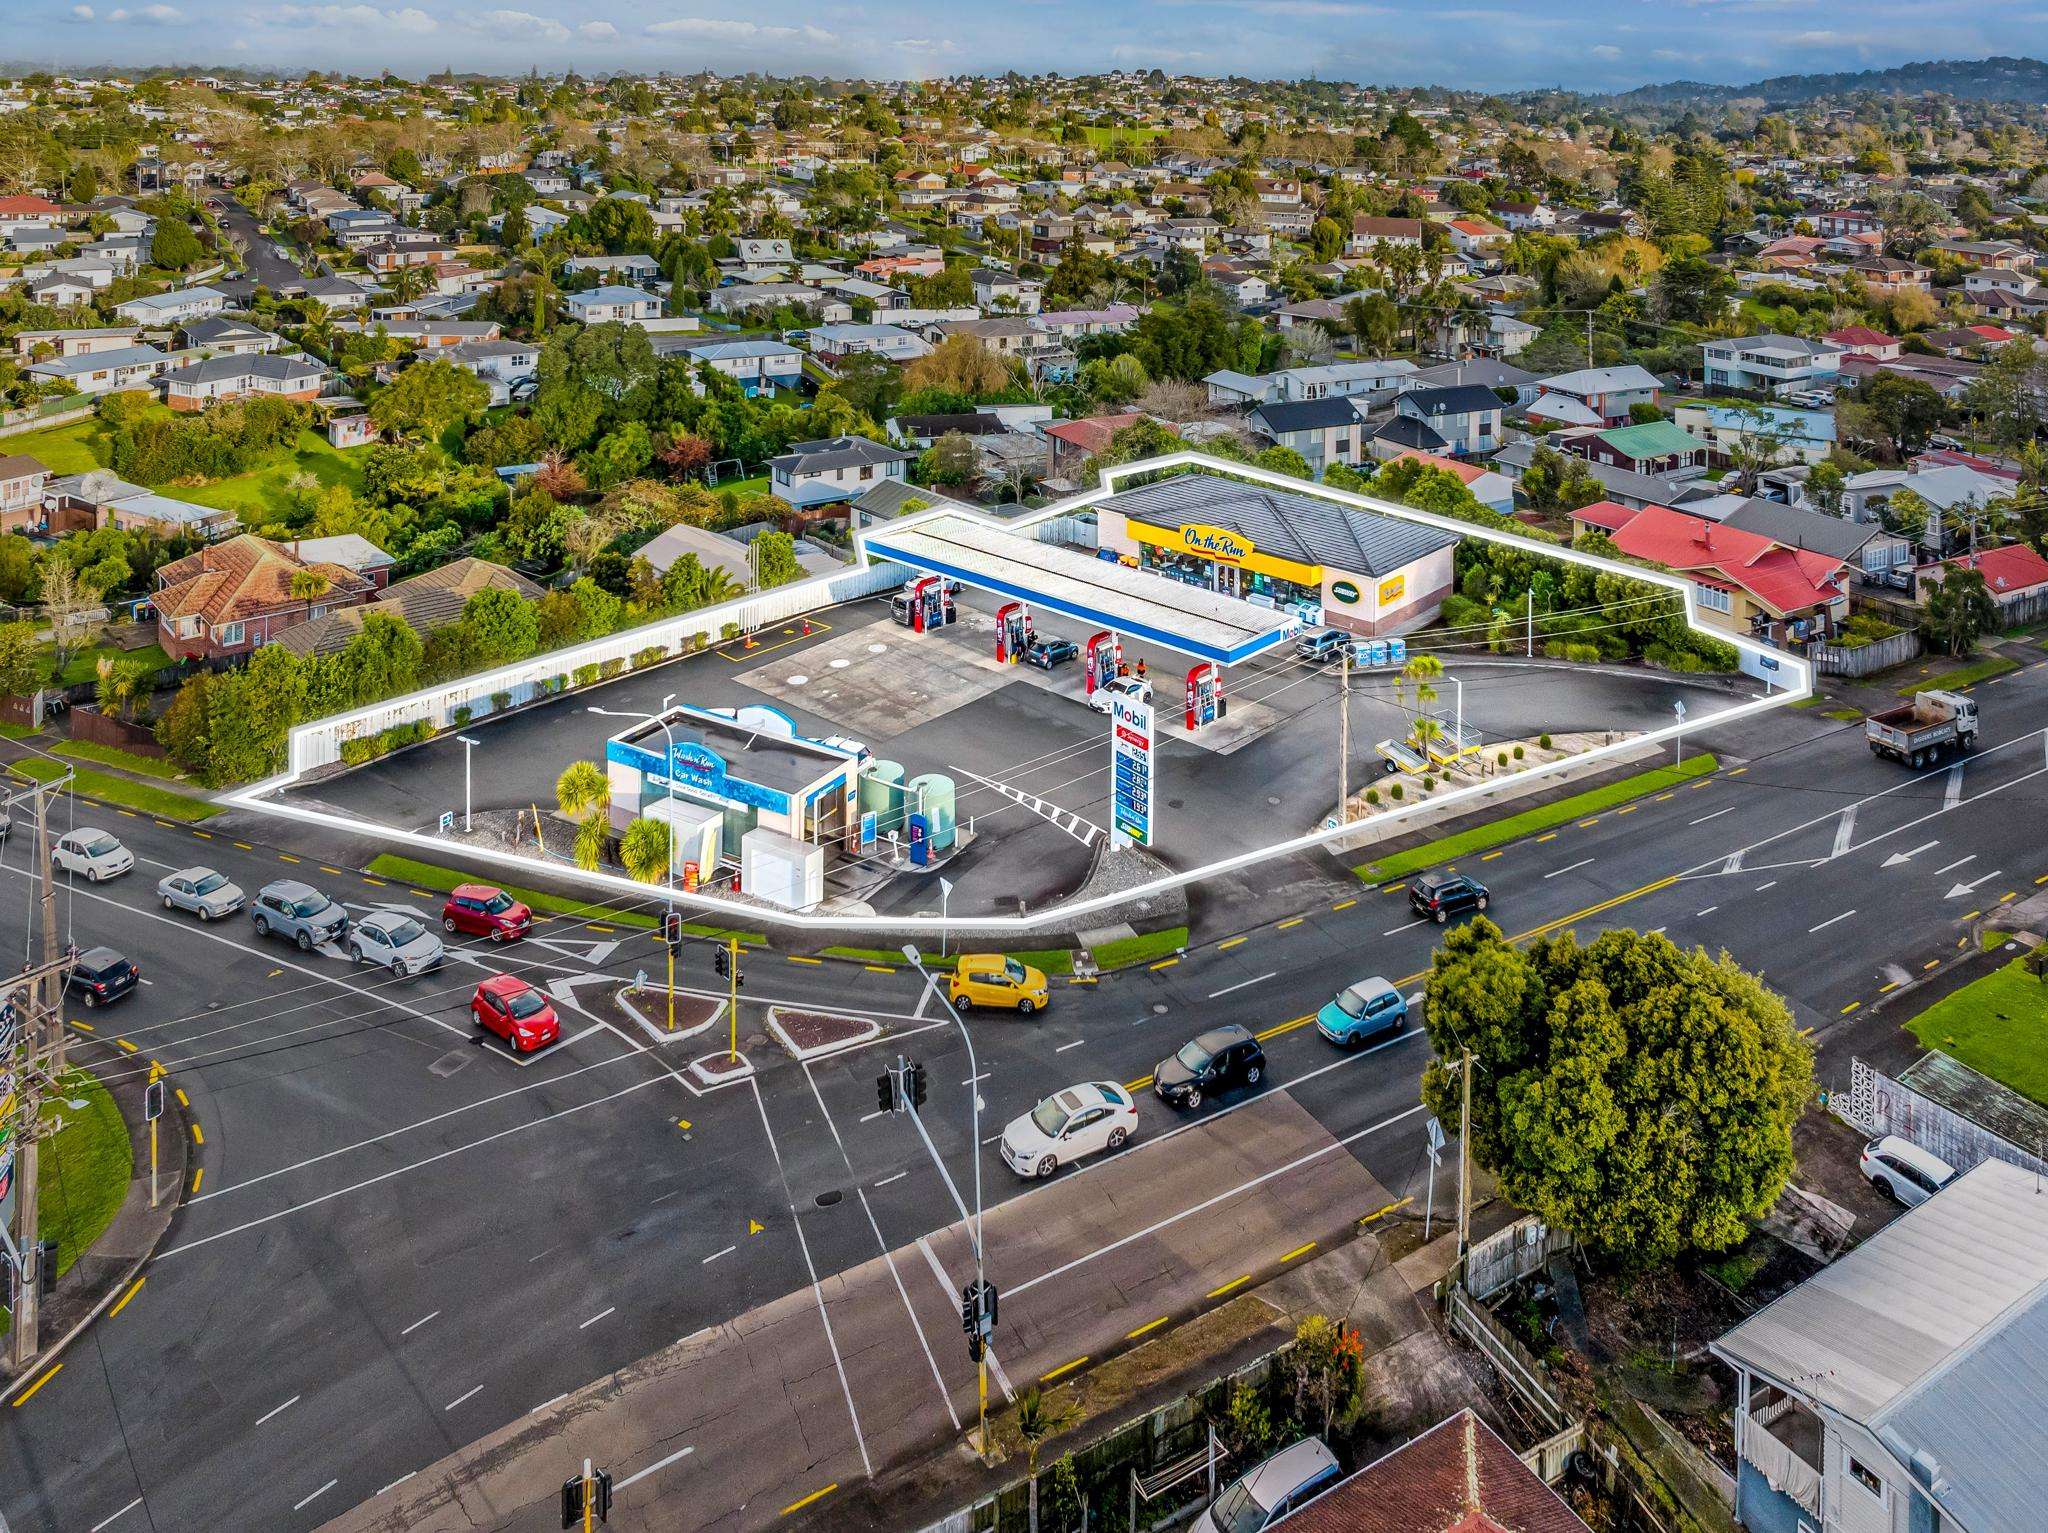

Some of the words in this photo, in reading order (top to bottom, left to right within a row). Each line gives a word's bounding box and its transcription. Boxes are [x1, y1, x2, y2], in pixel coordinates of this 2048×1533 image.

[1184, 527, 1202, 546] On
[1204, 533, 1221, 551] the
[1219, 536, 1247, 557] Run
[1282, 623, 1304, 641] Mobil
[1113, 701, 1147, 730] Mobil
[672, 747, 692, 762] Wash
[675, 769, 689, 779] Car
[691, 774, 713, 787] Wash
